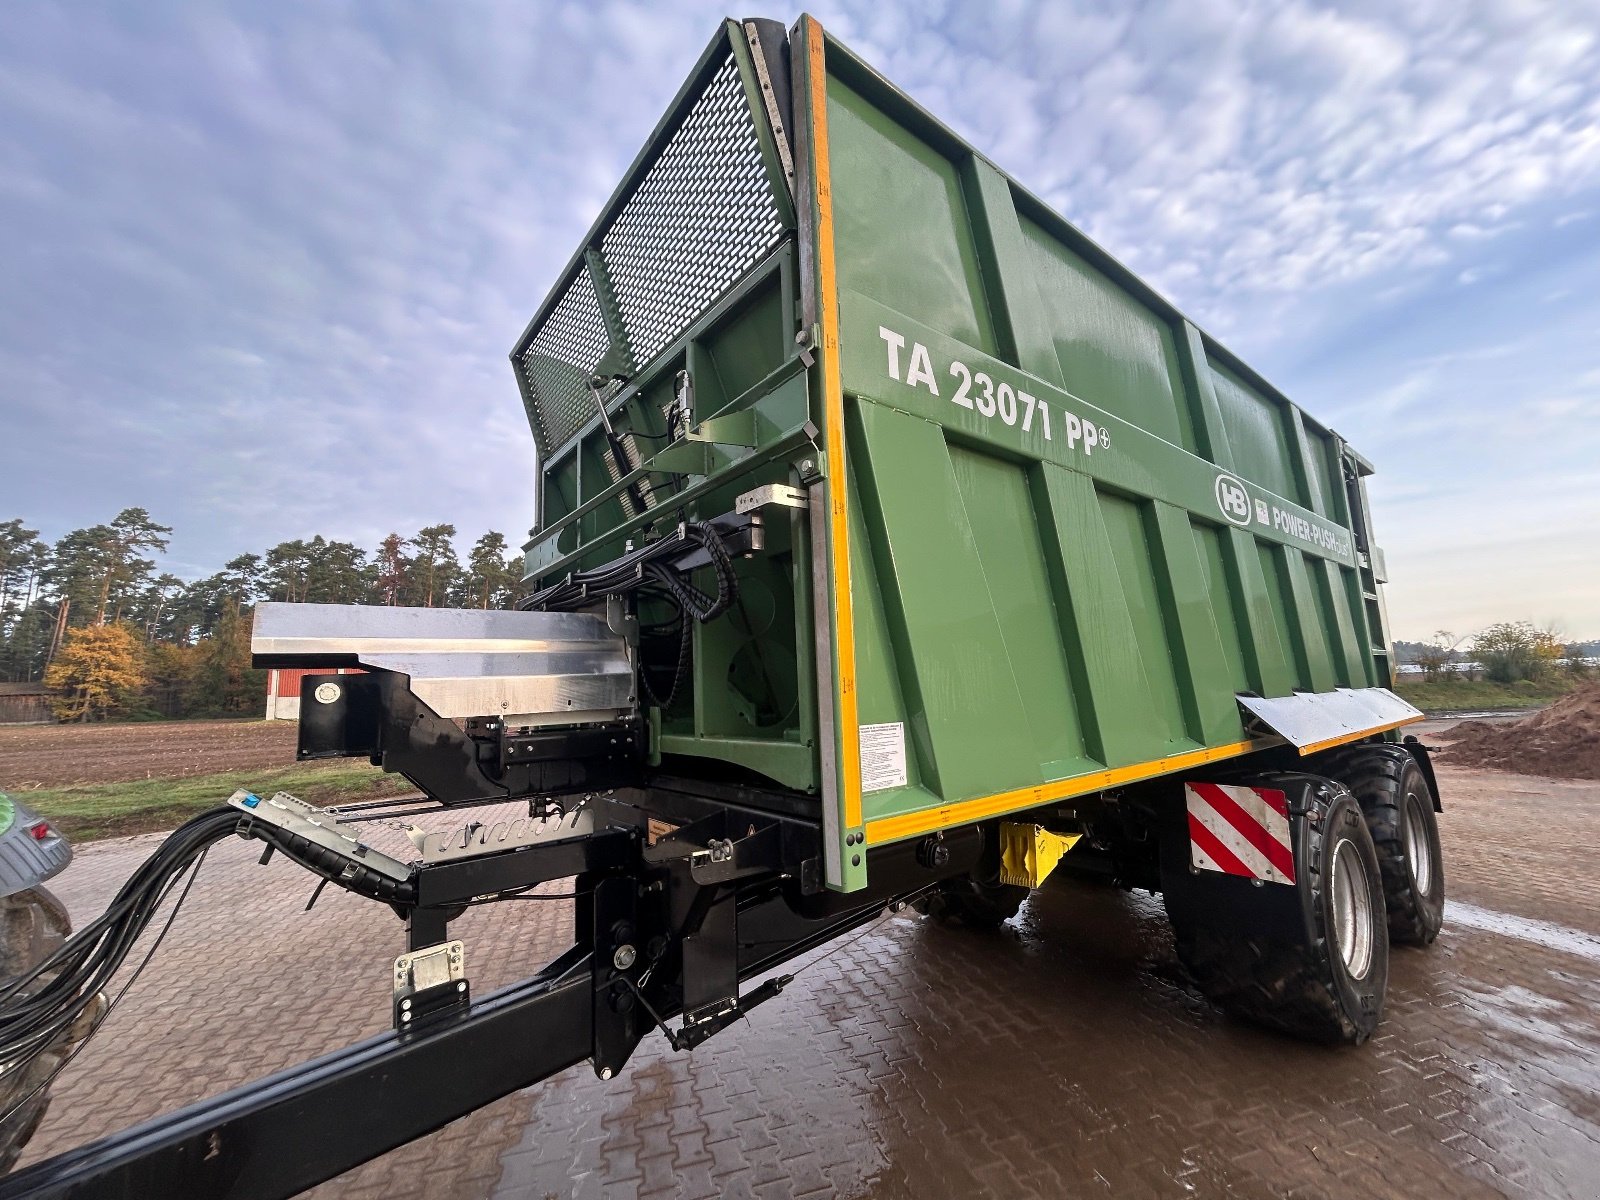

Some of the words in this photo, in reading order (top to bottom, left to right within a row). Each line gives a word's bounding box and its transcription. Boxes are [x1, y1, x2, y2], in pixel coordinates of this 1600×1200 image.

[879, 325, 939, 397] TA
[949, 361, 1051, 441] 23071
[1220, 481, 1247, 517] HB
